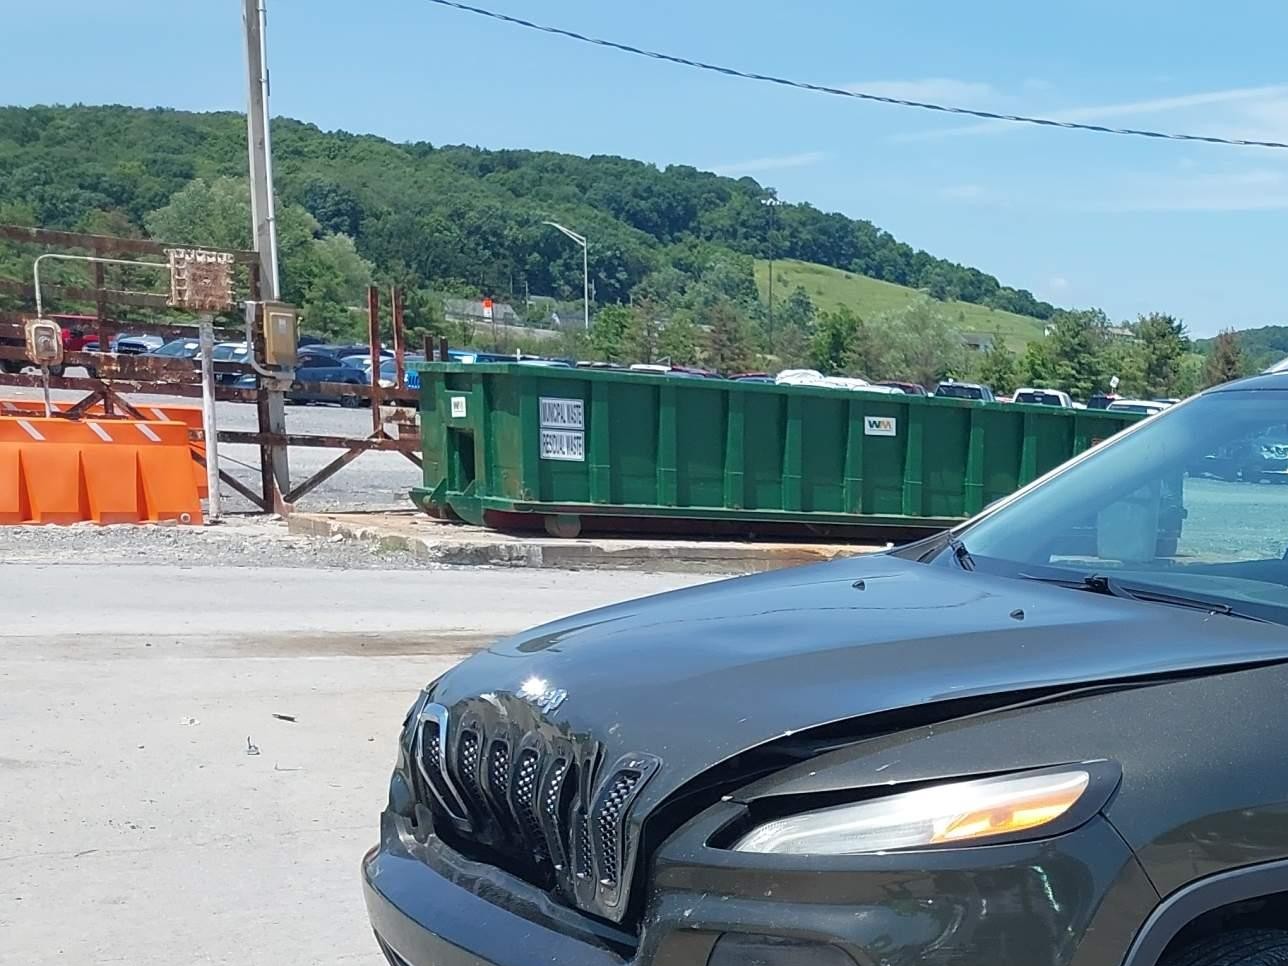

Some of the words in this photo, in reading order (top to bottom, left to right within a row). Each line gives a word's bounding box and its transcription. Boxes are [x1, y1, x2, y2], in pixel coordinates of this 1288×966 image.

[567, 403, 582, 425] WASTE
[868, 420, 892, 430] WM
[567, 435, 582, 456] WASTE
